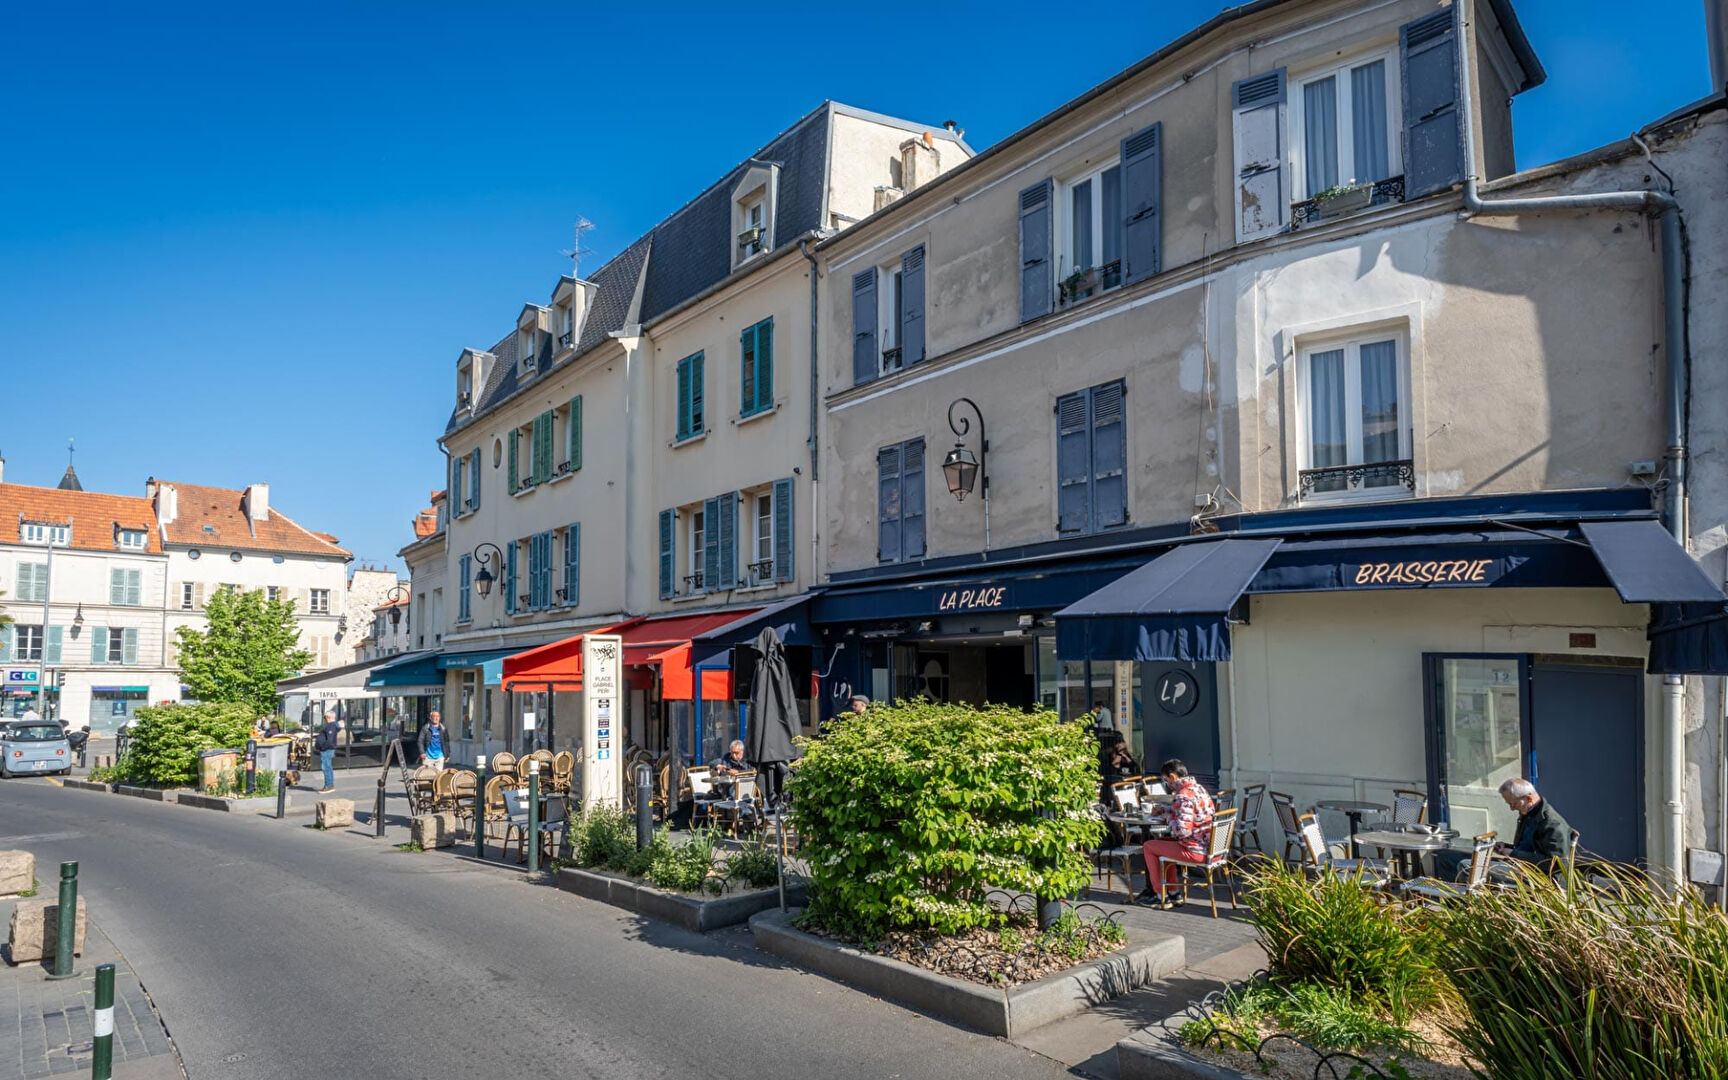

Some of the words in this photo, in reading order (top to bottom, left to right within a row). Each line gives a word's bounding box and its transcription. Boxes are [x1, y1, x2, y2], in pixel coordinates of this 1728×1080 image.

[1355, 559, 1493, 584] BRASSERIE
[940, 591, 957, 610] LA
[959, 587, 1006, 608] PLACE
[11, 671, 36, 680] CIC
[833, 681, 847, 699] LP
[1161, 679, 1187, 704] LP
